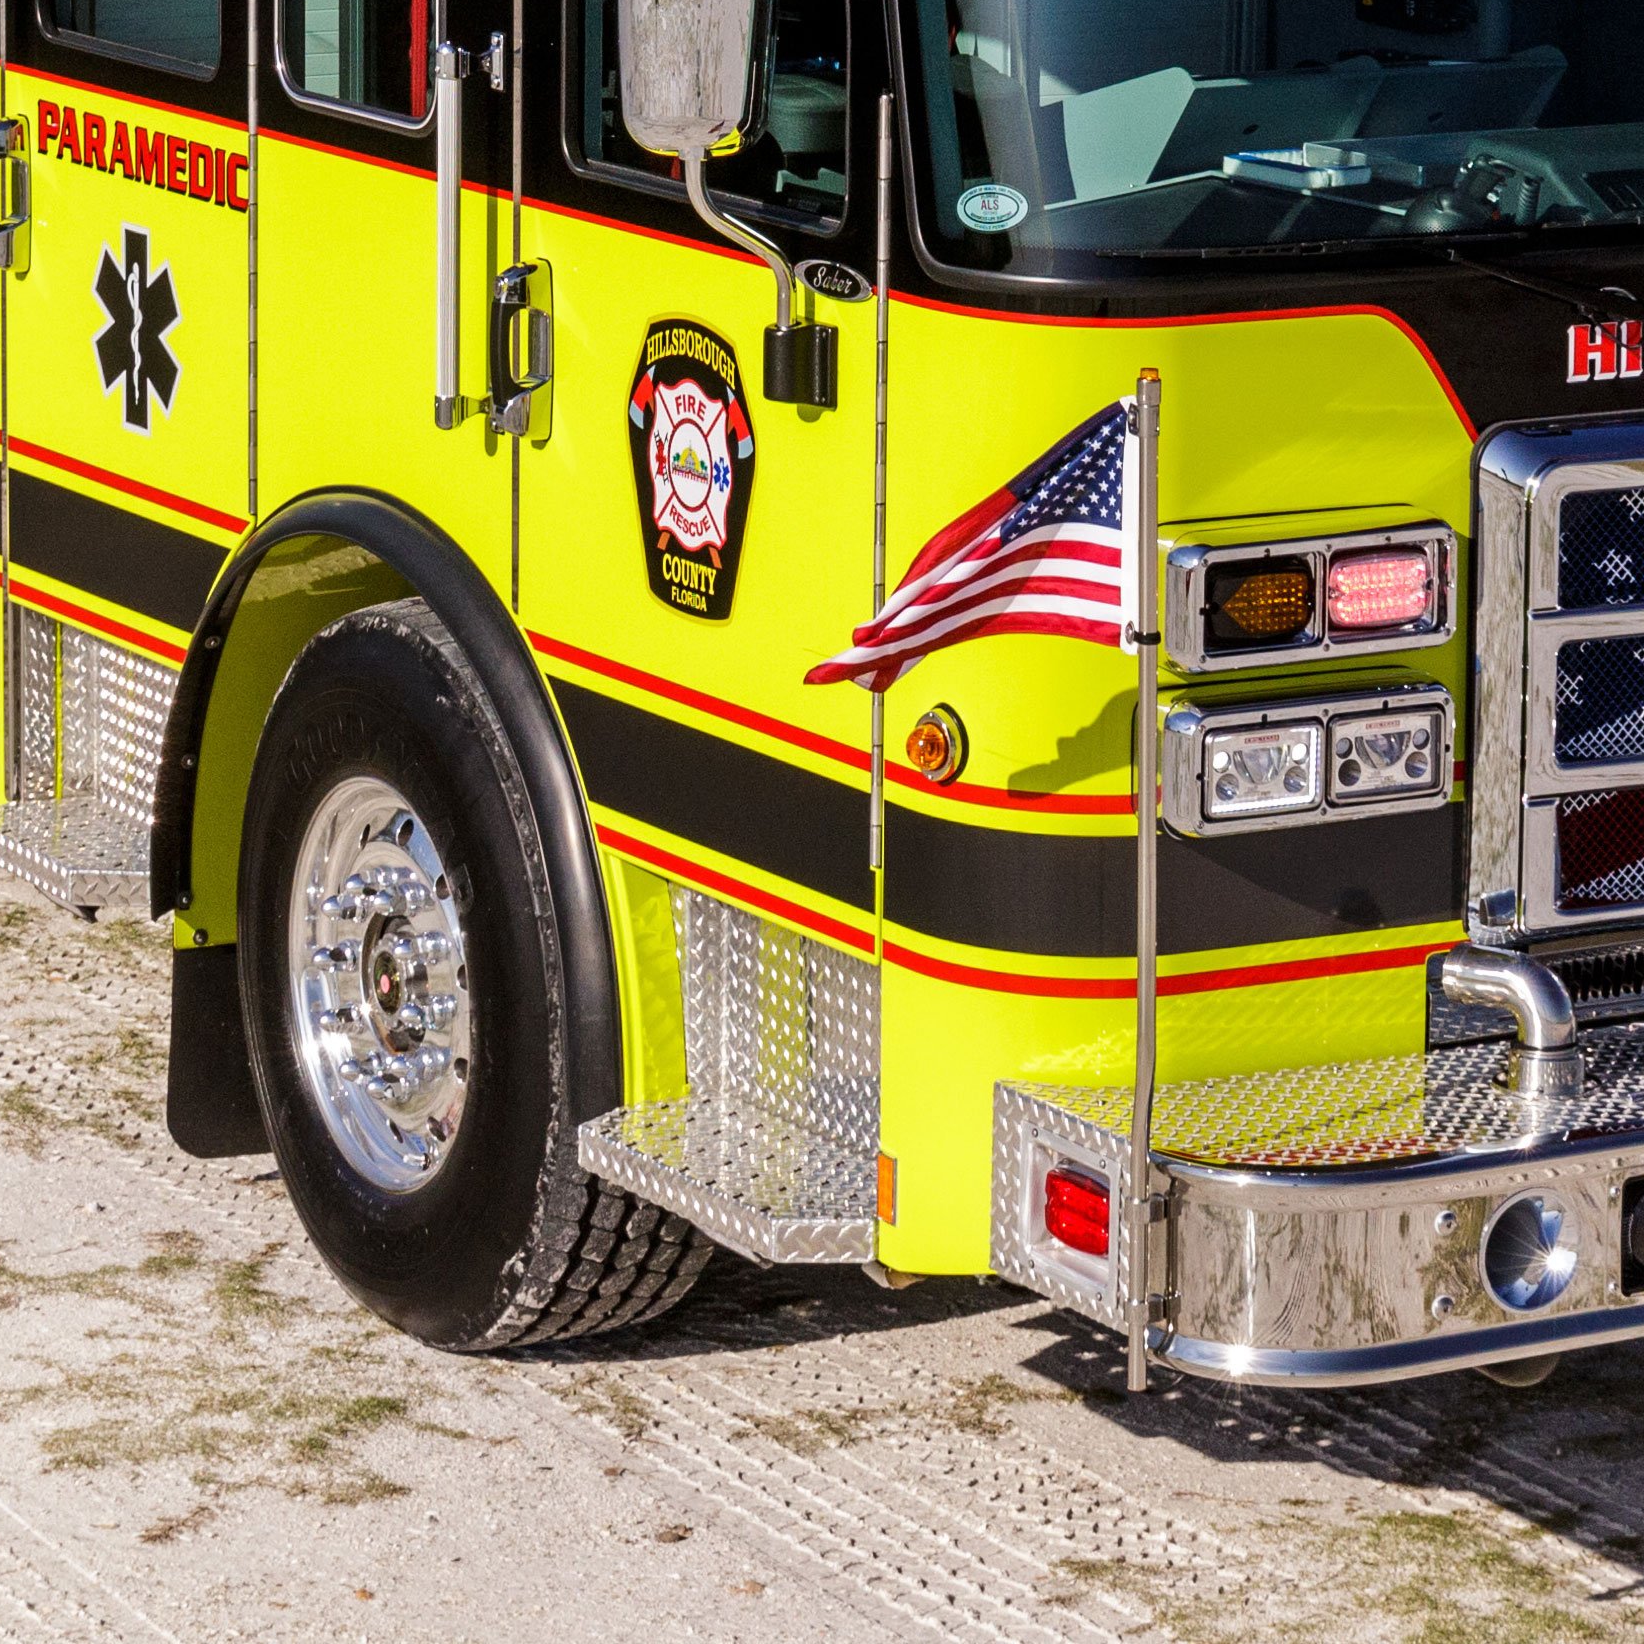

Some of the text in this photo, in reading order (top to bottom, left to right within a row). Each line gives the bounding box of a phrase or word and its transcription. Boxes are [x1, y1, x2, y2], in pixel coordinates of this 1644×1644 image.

[37, 99, 250, 213] PARAMEDIC
[981, 200, 999, 210] ALS
[814, 267, 852, 294] Saber
[646, 328, 736, 390] HILLSBOROUGH
[674, 394, 707, 422] FIRE
[669, 504, 711, 537] RESCUE
[662, 553, 717, 595] COUNTY
[672, 585, 707, 612] FLORIDA
